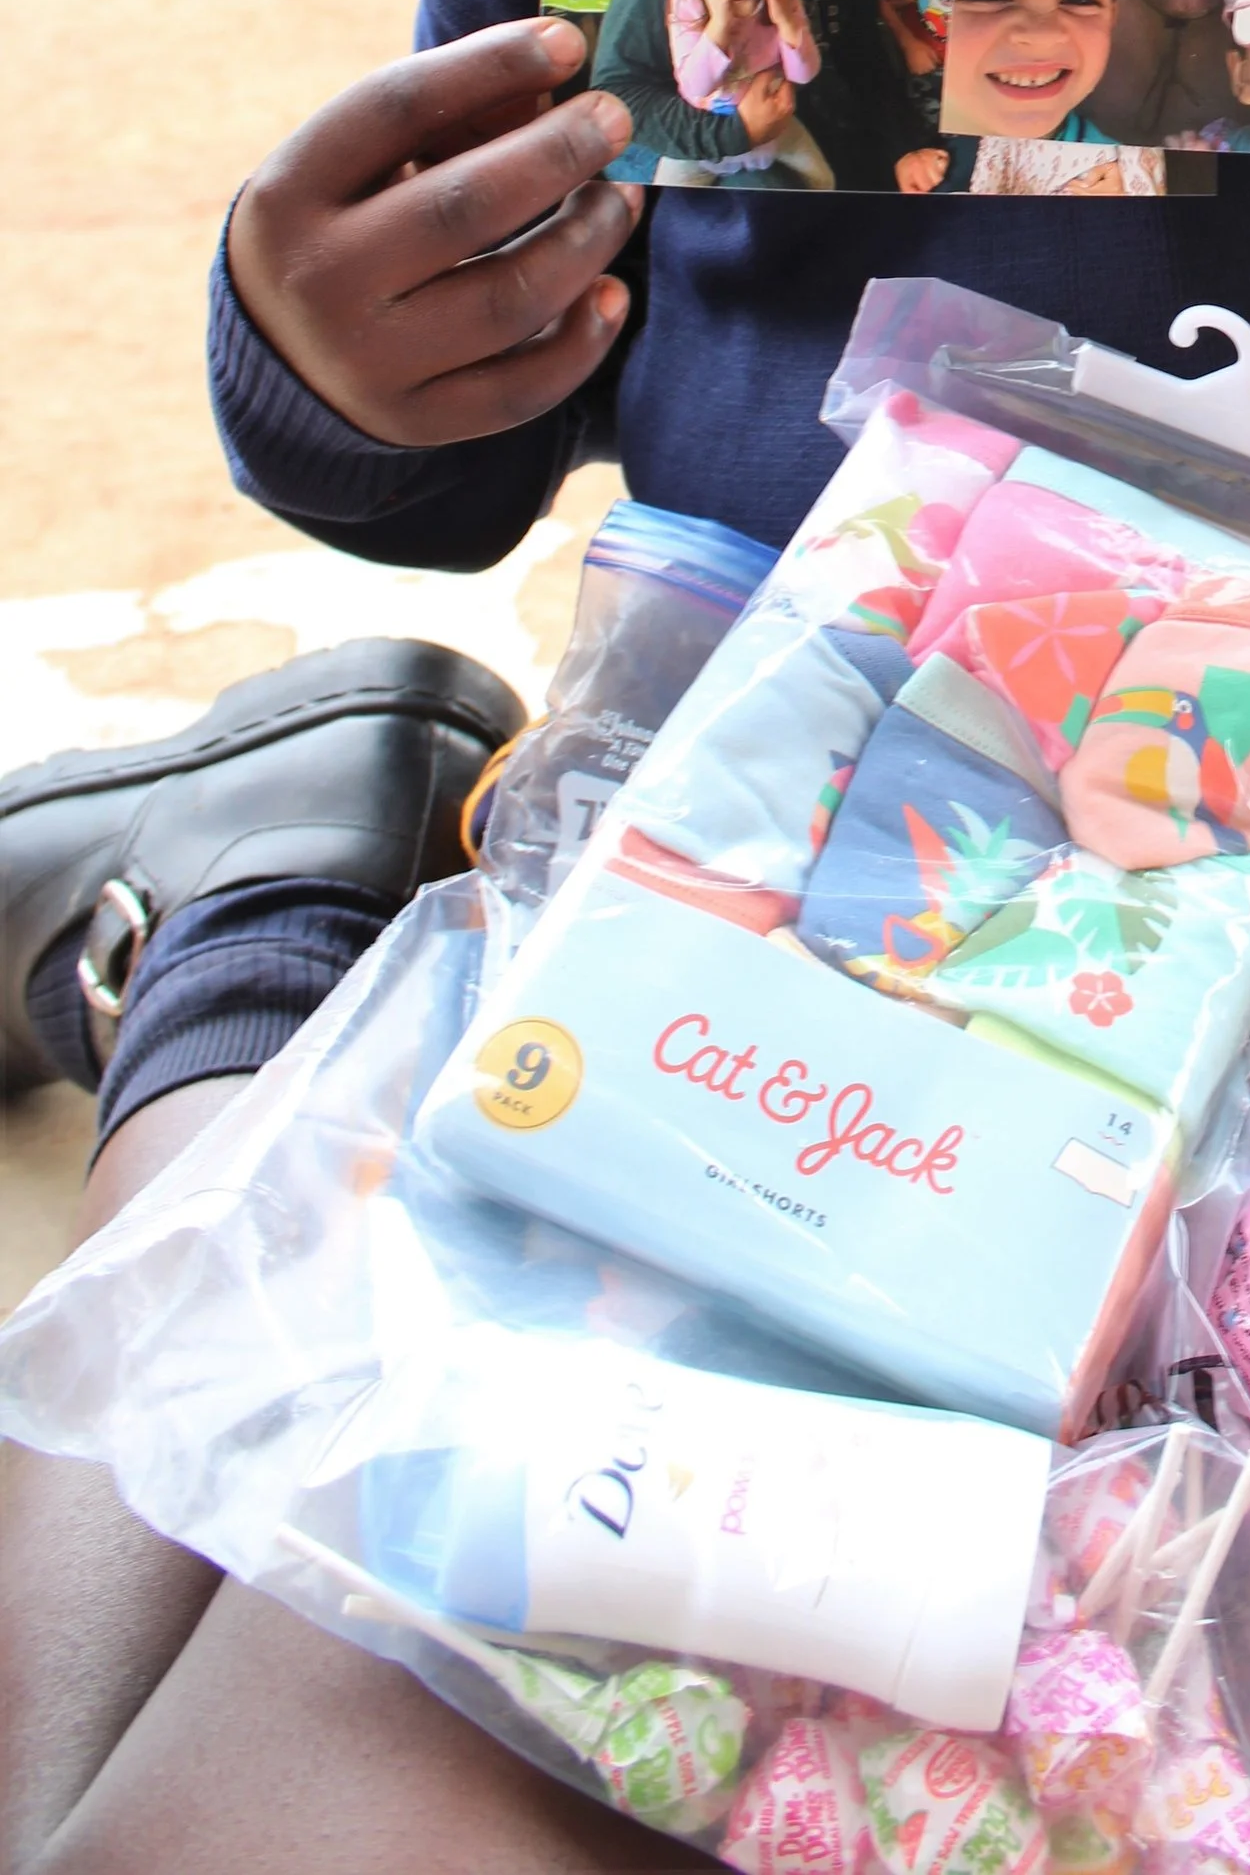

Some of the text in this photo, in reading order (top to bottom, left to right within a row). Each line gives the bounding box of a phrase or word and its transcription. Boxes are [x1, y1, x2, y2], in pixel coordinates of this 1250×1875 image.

[507, 1040, 552, 1092] 9
[491, 1090, 533, 1117] PACK
[652, 1012, 966, 1196] Cat & Jack
[1106, 1111, 1135, 1137] 14
